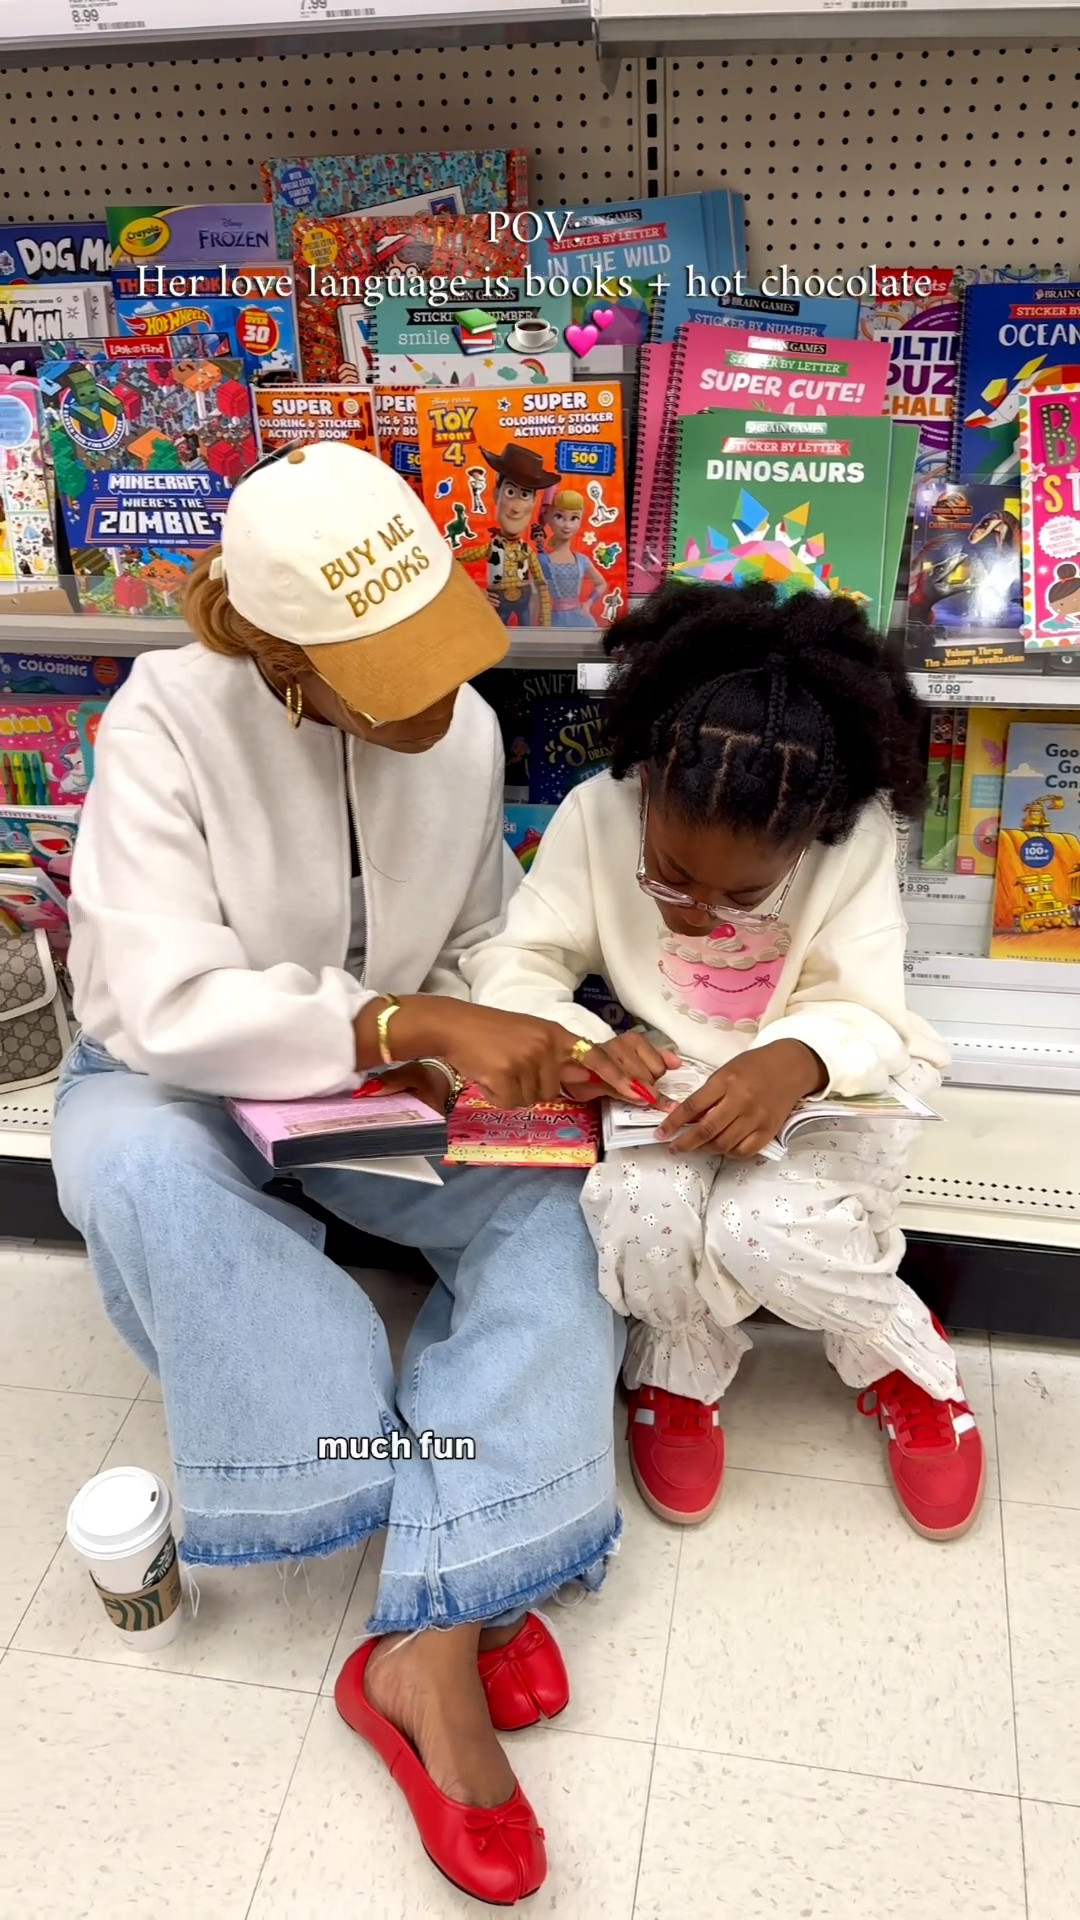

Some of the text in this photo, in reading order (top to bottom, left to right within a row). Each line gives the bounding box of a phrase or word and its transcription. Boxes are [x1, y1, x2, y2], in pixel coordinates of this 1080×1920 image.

[71, 9, 99, 23] 8.99
[127, 224, 163, 240] Crayola
[199, 230, 269, 249] FROZEN
[603, 232, 616, 243] BY
[618, 227, 661, 241] LETTER
[16, 237, 113, 276] DOG MA
[547, 244, 671, 278] IN THE WILD
[1045, 290, 1075, 299] BRAIN
[731, 297, 796, 313] BRAIN GAMES
[1016, 306, 1067, 316] STICKER
[10, 307, 63, 342] MAN
[146, 307, 208, 335] HOT WHEELS
[413, 311, 455, 323] STICK
[243, 324, 270, 343] 30
[694, 313, 819, 338] STICKER BY NUMBER
[398, 329, 450, 346] smile
[790, 342, 826, 354] GAMES
[780, 358, 795, 369] BY
[797, 361, 840, 374] LETTER
[699, 368, 867, 404] SUPER CUTE!
[271, 398, 334, 416] SUPER
[375, 396, 417, 412] UPER
[523, 392, 588, 411] SUPER
[260, 418, 362, 429] OLORING & STICKER
[428, 406, 478, 432] TOY
[499, 412, 614, 427] COLORING & STICKER
[268, 429, 349, 439] ACTIVITY BOOK
[435, 432, 471, 442] STORY
[514, 423, 600, 438] ACTIVITY BOOK
[756, 423, 824, 435] BRAIN GAMES
[443, 441, 466, 466] 4
[731, 441, 843, 454] STICKER BY LETTER
[571, 451, 599, 465] 500
[706, 459, 866, 484] DINOSAURS
[109, 474, 211, 493] MINECRAFT
[122, 498, 205, 509] WHERE'S THE
[320, 513, 415, 591] BUY ME
[345, 545, 430, 618] BOOKS
[944, 646, 1004, 658] Volume Three
[18, 659, 88, 677] COLORING
[924, 654, 1026, 668] The Junior Novelization
[927, 683, 961, 695] 10.99
[580, 703, 601, 721] MY
[1045, 743, 1080, 757] Goo
[1025, 847, 1049, 856] 100+
[907, 883, 930, 893] 9.99
[468, 1111, 576, 1124] Wimpy Kid
